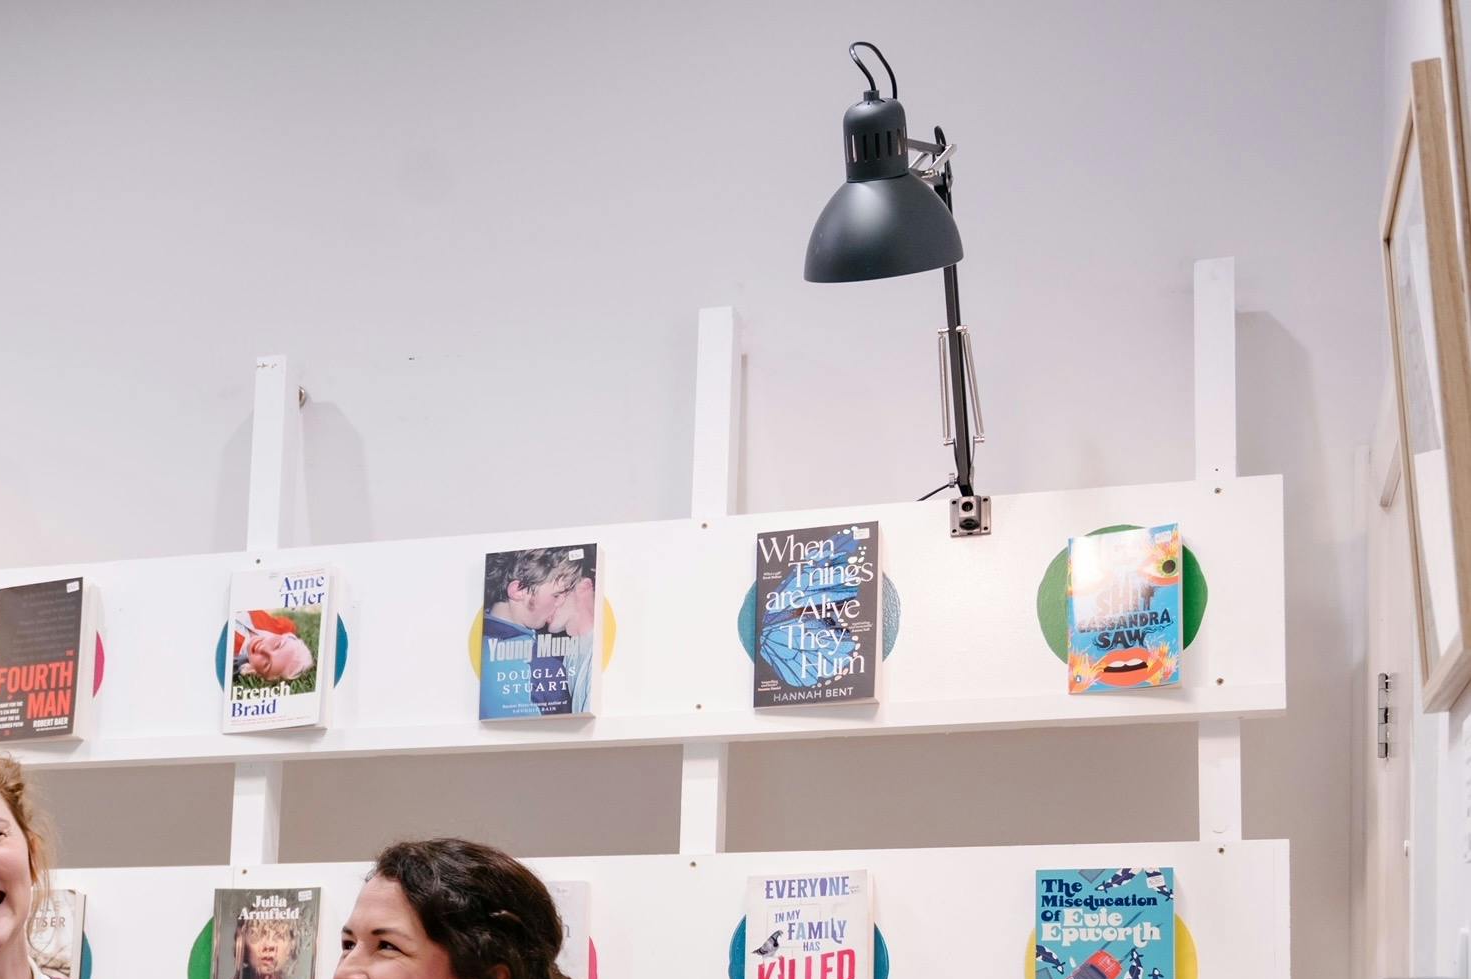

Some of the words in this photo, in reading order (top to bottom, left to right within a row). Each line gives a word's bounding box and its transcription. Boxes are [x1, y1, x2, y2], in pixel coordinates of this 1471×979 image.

[759, 536, 835, 565] When
[279, 577, 325, 592] Anne
[788, 561, 874, 591] Things
[280, 591, 325, 609] Tyler
[765, 590, 805, 611] are
[799, 599, 861, 623] Alive
[780, 624, 846, 656] They
[1096, 628, 1148, 650] SAW
[497, 666, 577, 682] DOUGLAS
[800, 653, 865, 680] Hum
[502, 680, 568, 695] STUART
[773, 689, 822, 702] HANNAH
[826, 687, 854, 698] BENT
[26, 689, 72, 721] MAN
[231, 700, 277, 718] Braid
[764, 875, 849, 900] EVERYONE
[1041, 879, 1084, 898] The
[251, 895, 288, 909] Julia
[1041, 895, 1158, 911] Miseducation
[238, 907, 301, 921] Armfield
[774, 912, 785, 924] IN
[785, 909, 801, 921] MY
[787, 917, 847, 945] FAMILY
[1041, 922, 1162, 948] Epworth
[802, 942, 821, 952] HAS
